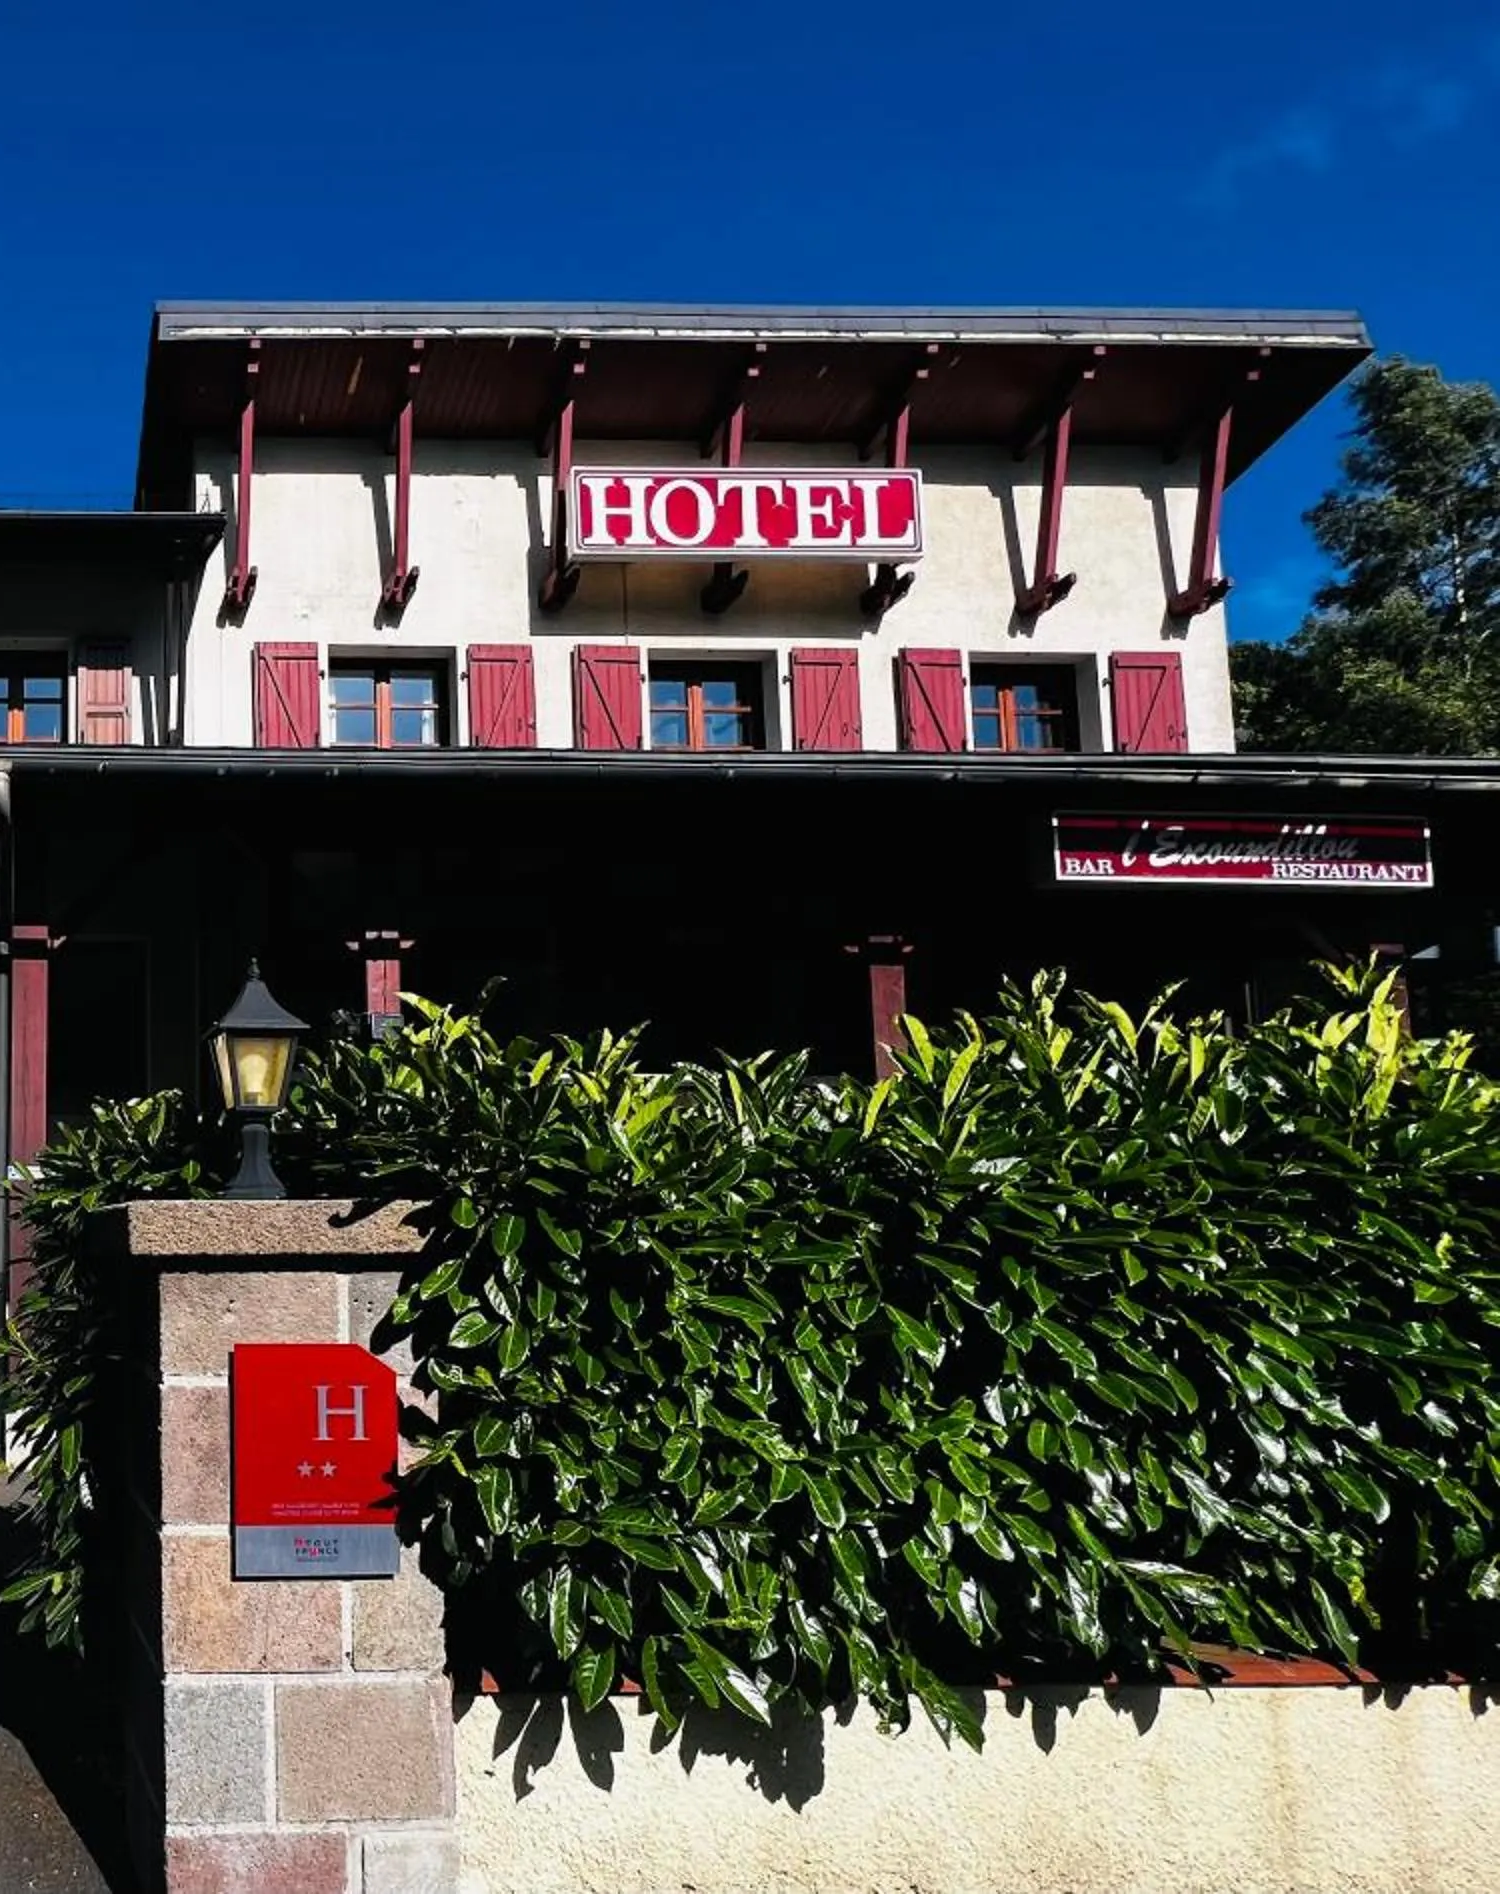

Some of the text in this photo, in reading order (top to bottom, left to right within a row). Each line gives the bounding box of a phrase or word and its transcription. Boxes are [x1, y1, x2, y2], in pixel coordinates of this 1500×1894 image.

[581, 478, 914, 547] HOTEL
[1064, 857, 1114, 875] BAR
[1272, 863, 1424, 881] RESTAURANT
[312, 1385, 370, 1441] H
